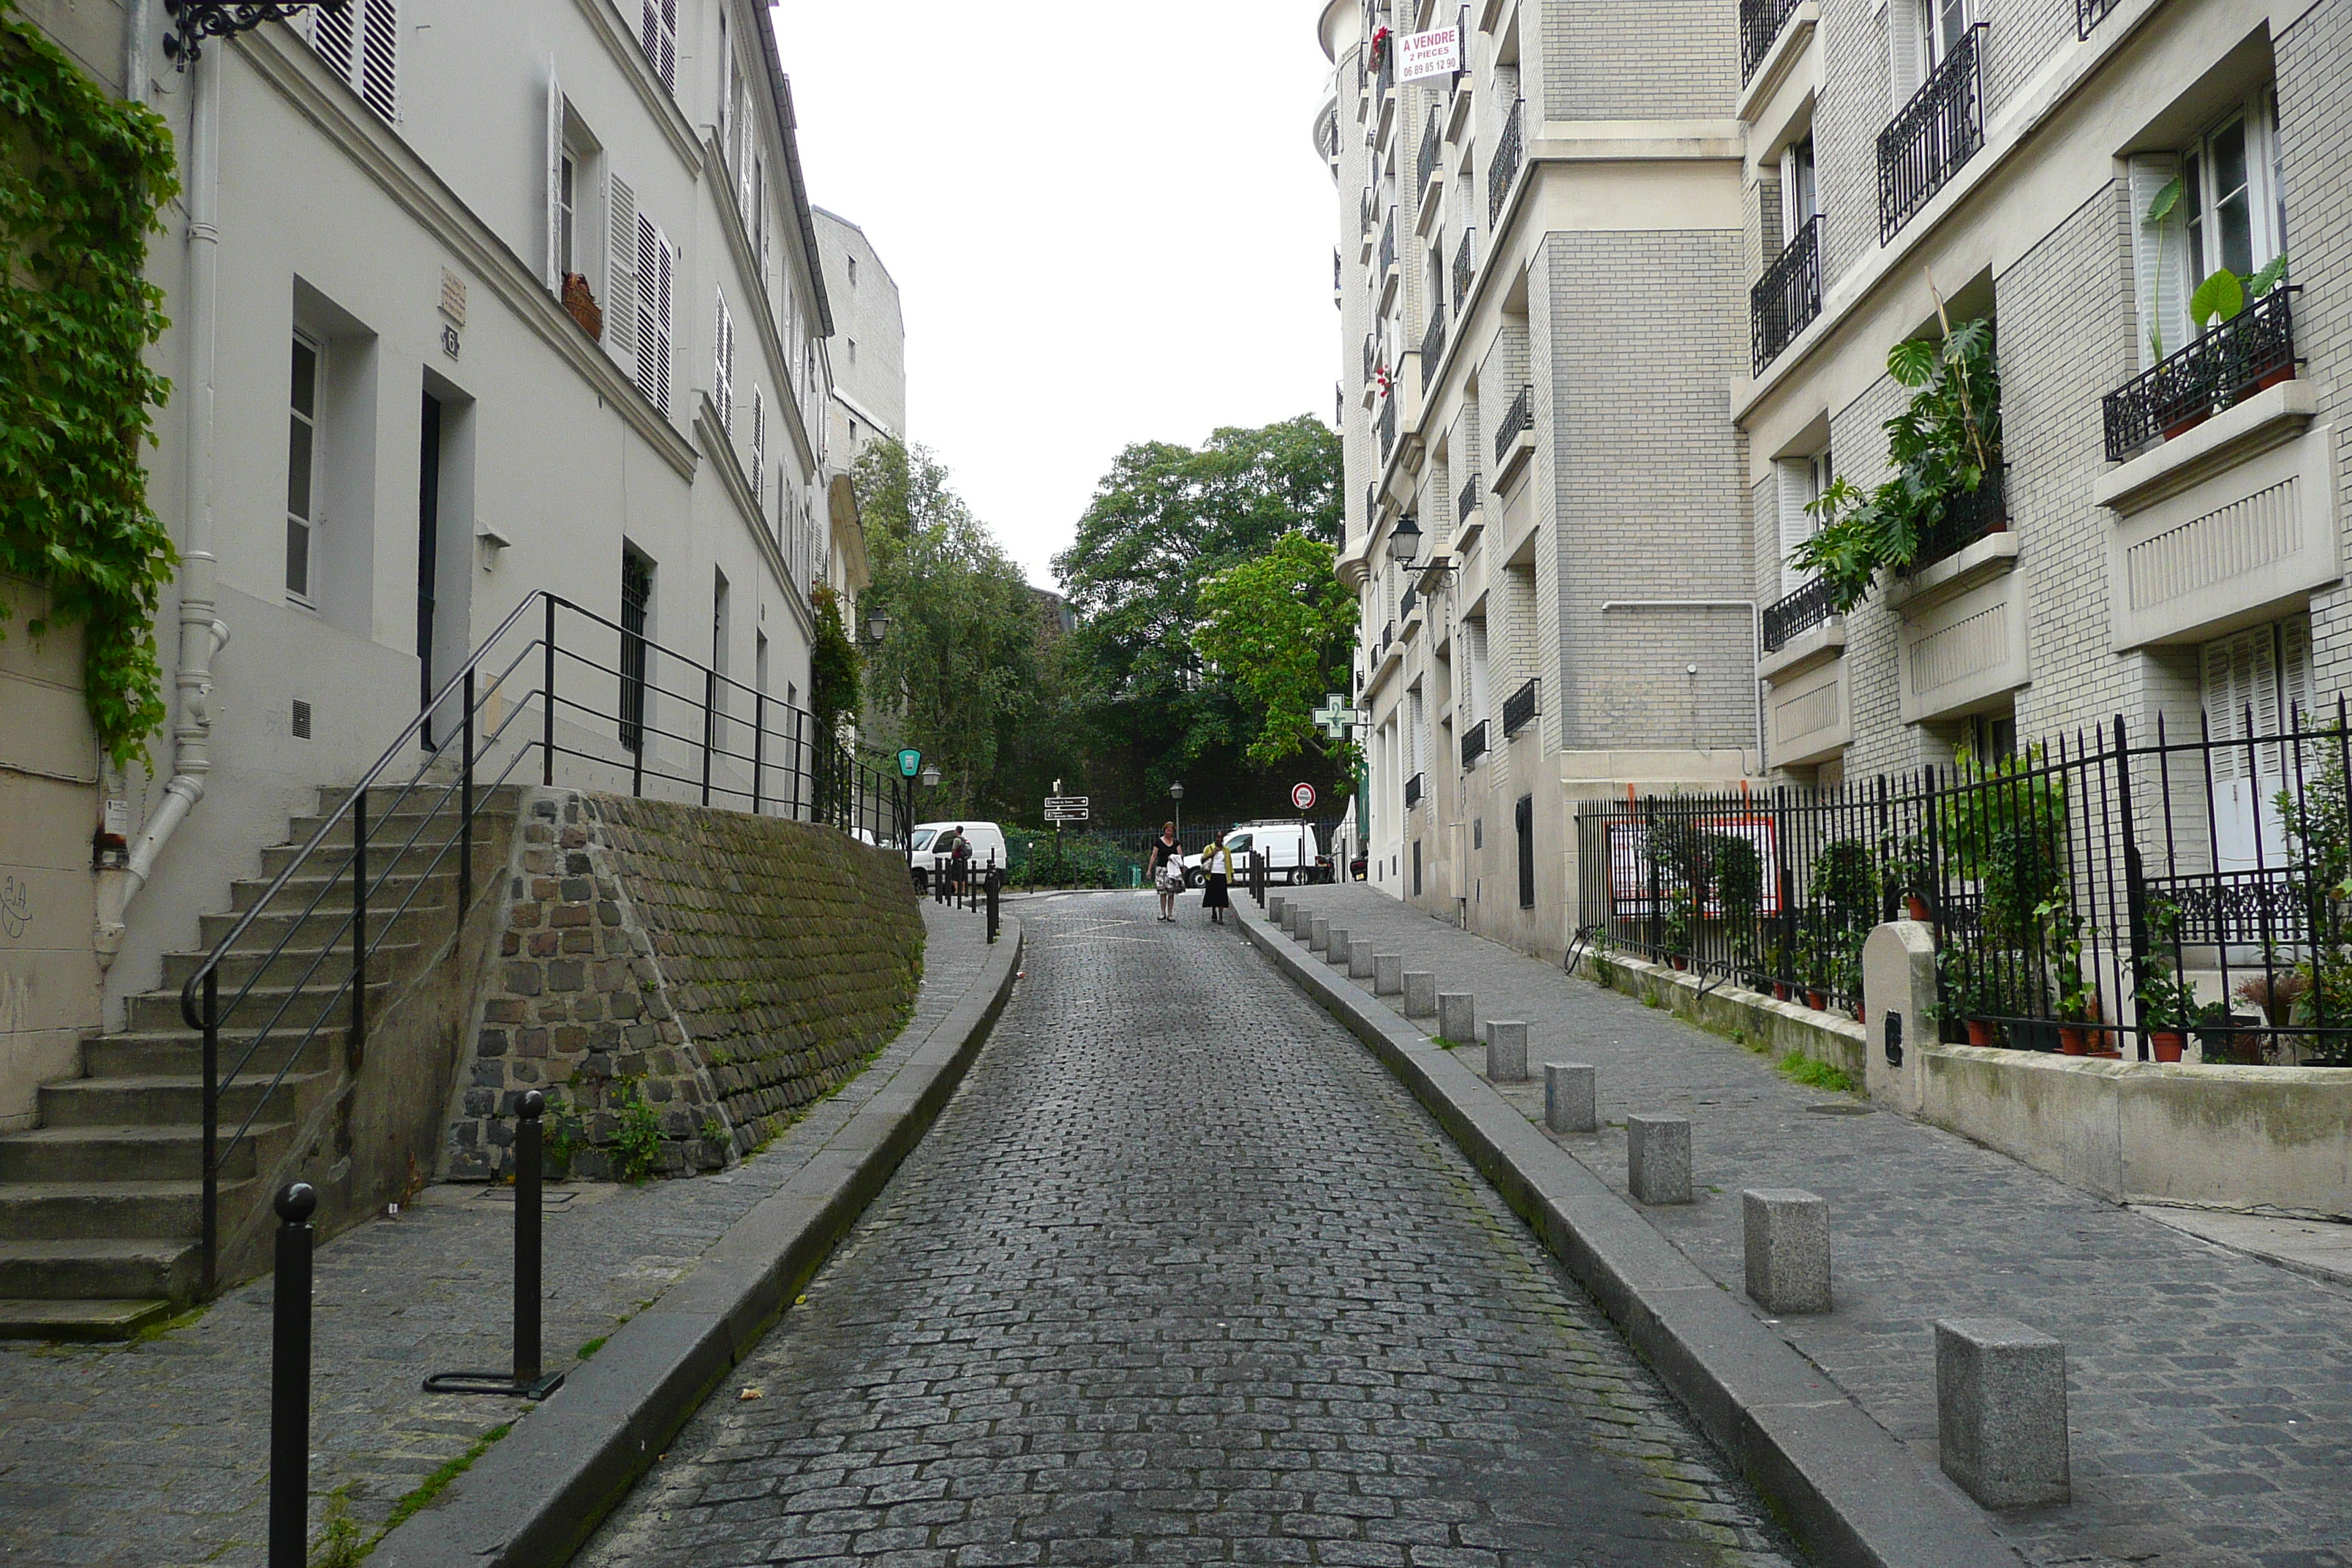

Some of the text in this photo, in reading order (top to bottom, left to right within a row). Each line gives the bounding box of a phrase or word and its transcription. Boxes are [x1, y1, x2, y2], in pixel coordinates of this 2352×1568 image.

[1403, 30, 1455, 52] A VENDRE
[1410, 47, 1450, 61] 2 PIECES
[1404, 57, 1455, 77] 06 89 85 12 90
[448, 331, 455, 352] 6
